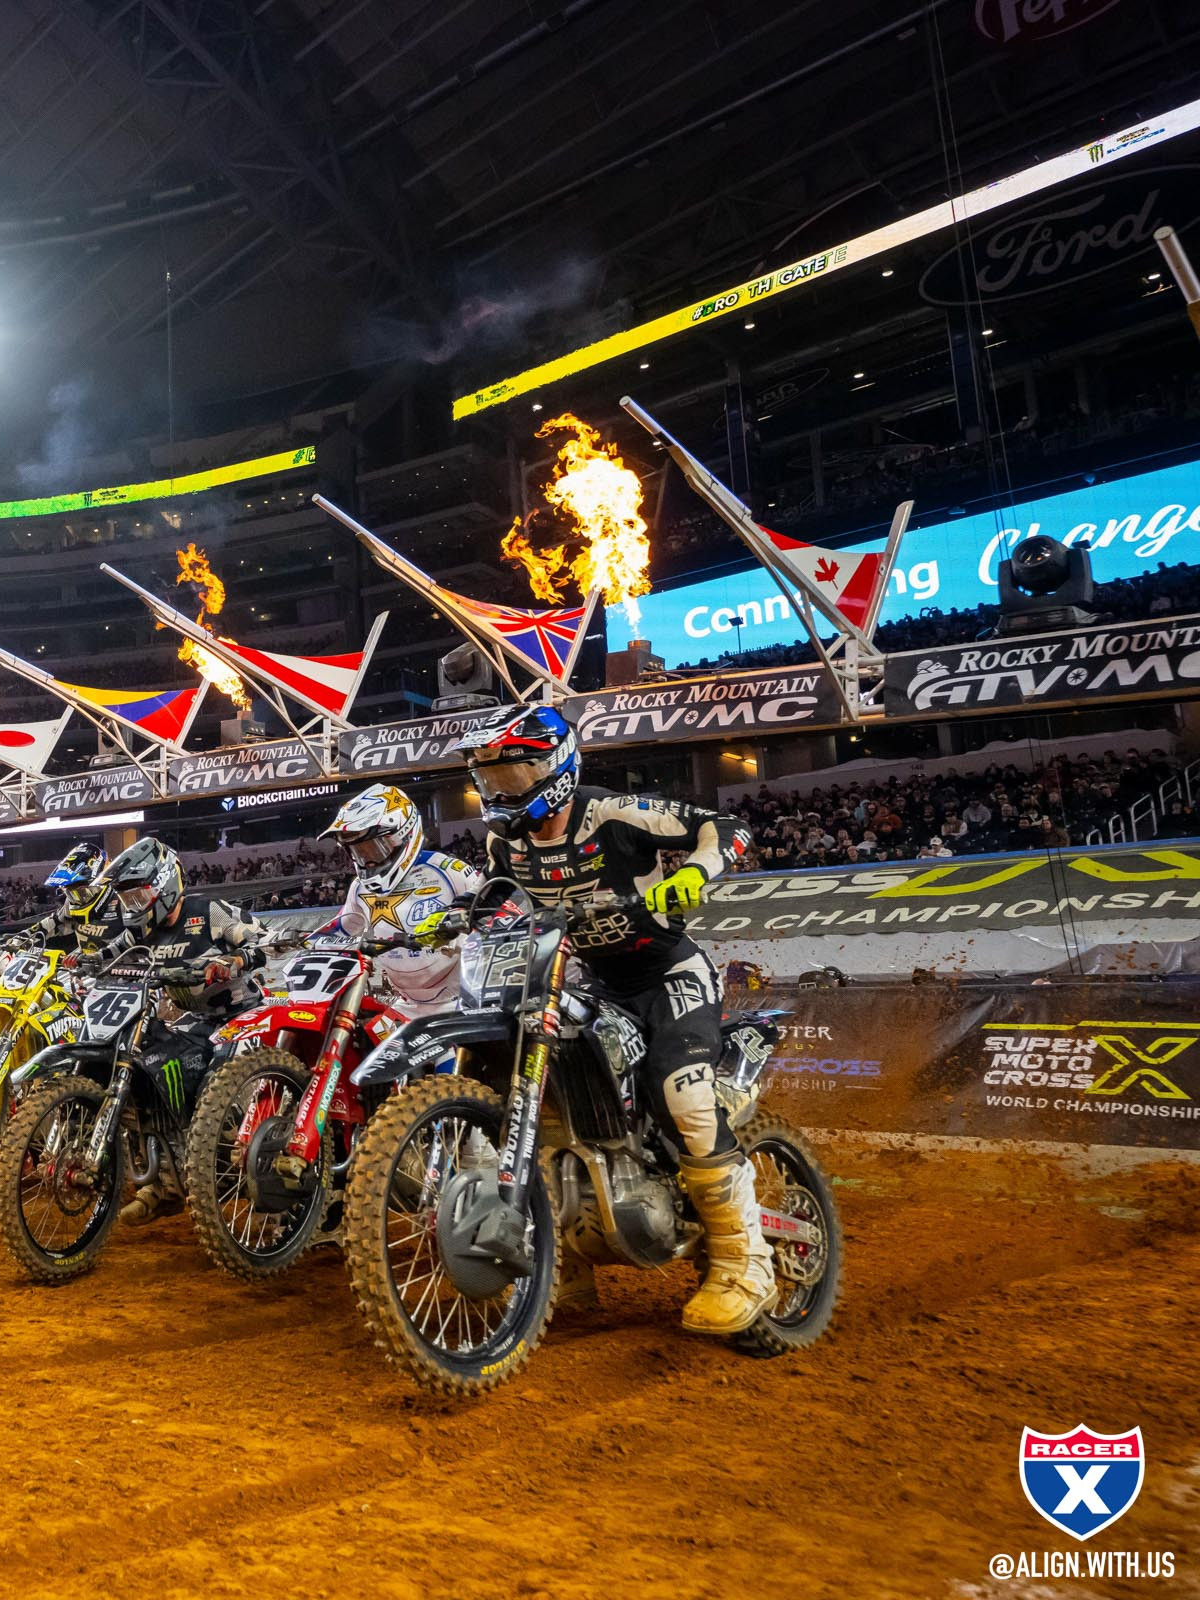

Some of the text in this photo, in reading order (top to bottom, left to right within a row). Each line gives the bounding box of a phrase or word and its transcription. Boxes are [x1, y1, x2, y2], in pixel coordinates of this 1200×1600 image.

[977, 189, 1164, 293] Ford
[779, 257, 826, 285] GATE
[955, 626, 1200, 673] ROCKY MOUNT
[611, 676, 820, 712] ROCKY MOUNTAIN
[377, 716, 487, 744] ROCKY MOUN
[197, 754, 235, 769] ROCKY
[57, 769, 145, 793] ROCKY MOUNTAIN
[722, 828, 751, 863] froth
[540, 866, 575, 880] froth
[149, 942, 191, 959] LEATT
[4, 958, 44, 985] 45
[293, 957, 357, 993] 51
[88, 992, 139, 1026] 46
[730, 1027, 774, 1064] 12
[983, 1036, 1098, 1055] SUPER
[991, 1053, 1092, 1072] MOTO
[322, 1065, 342, 1111] MOTOREX
[675, 1067, 706, 1093] FLY
[984, 1070, 1096, 1089] CROSS
[986, 1095, 1049, 1109] WORLD
[503, 1092, 524, 1169] DUNLO
[481, 1338, 527, 1375] DUNLOP
